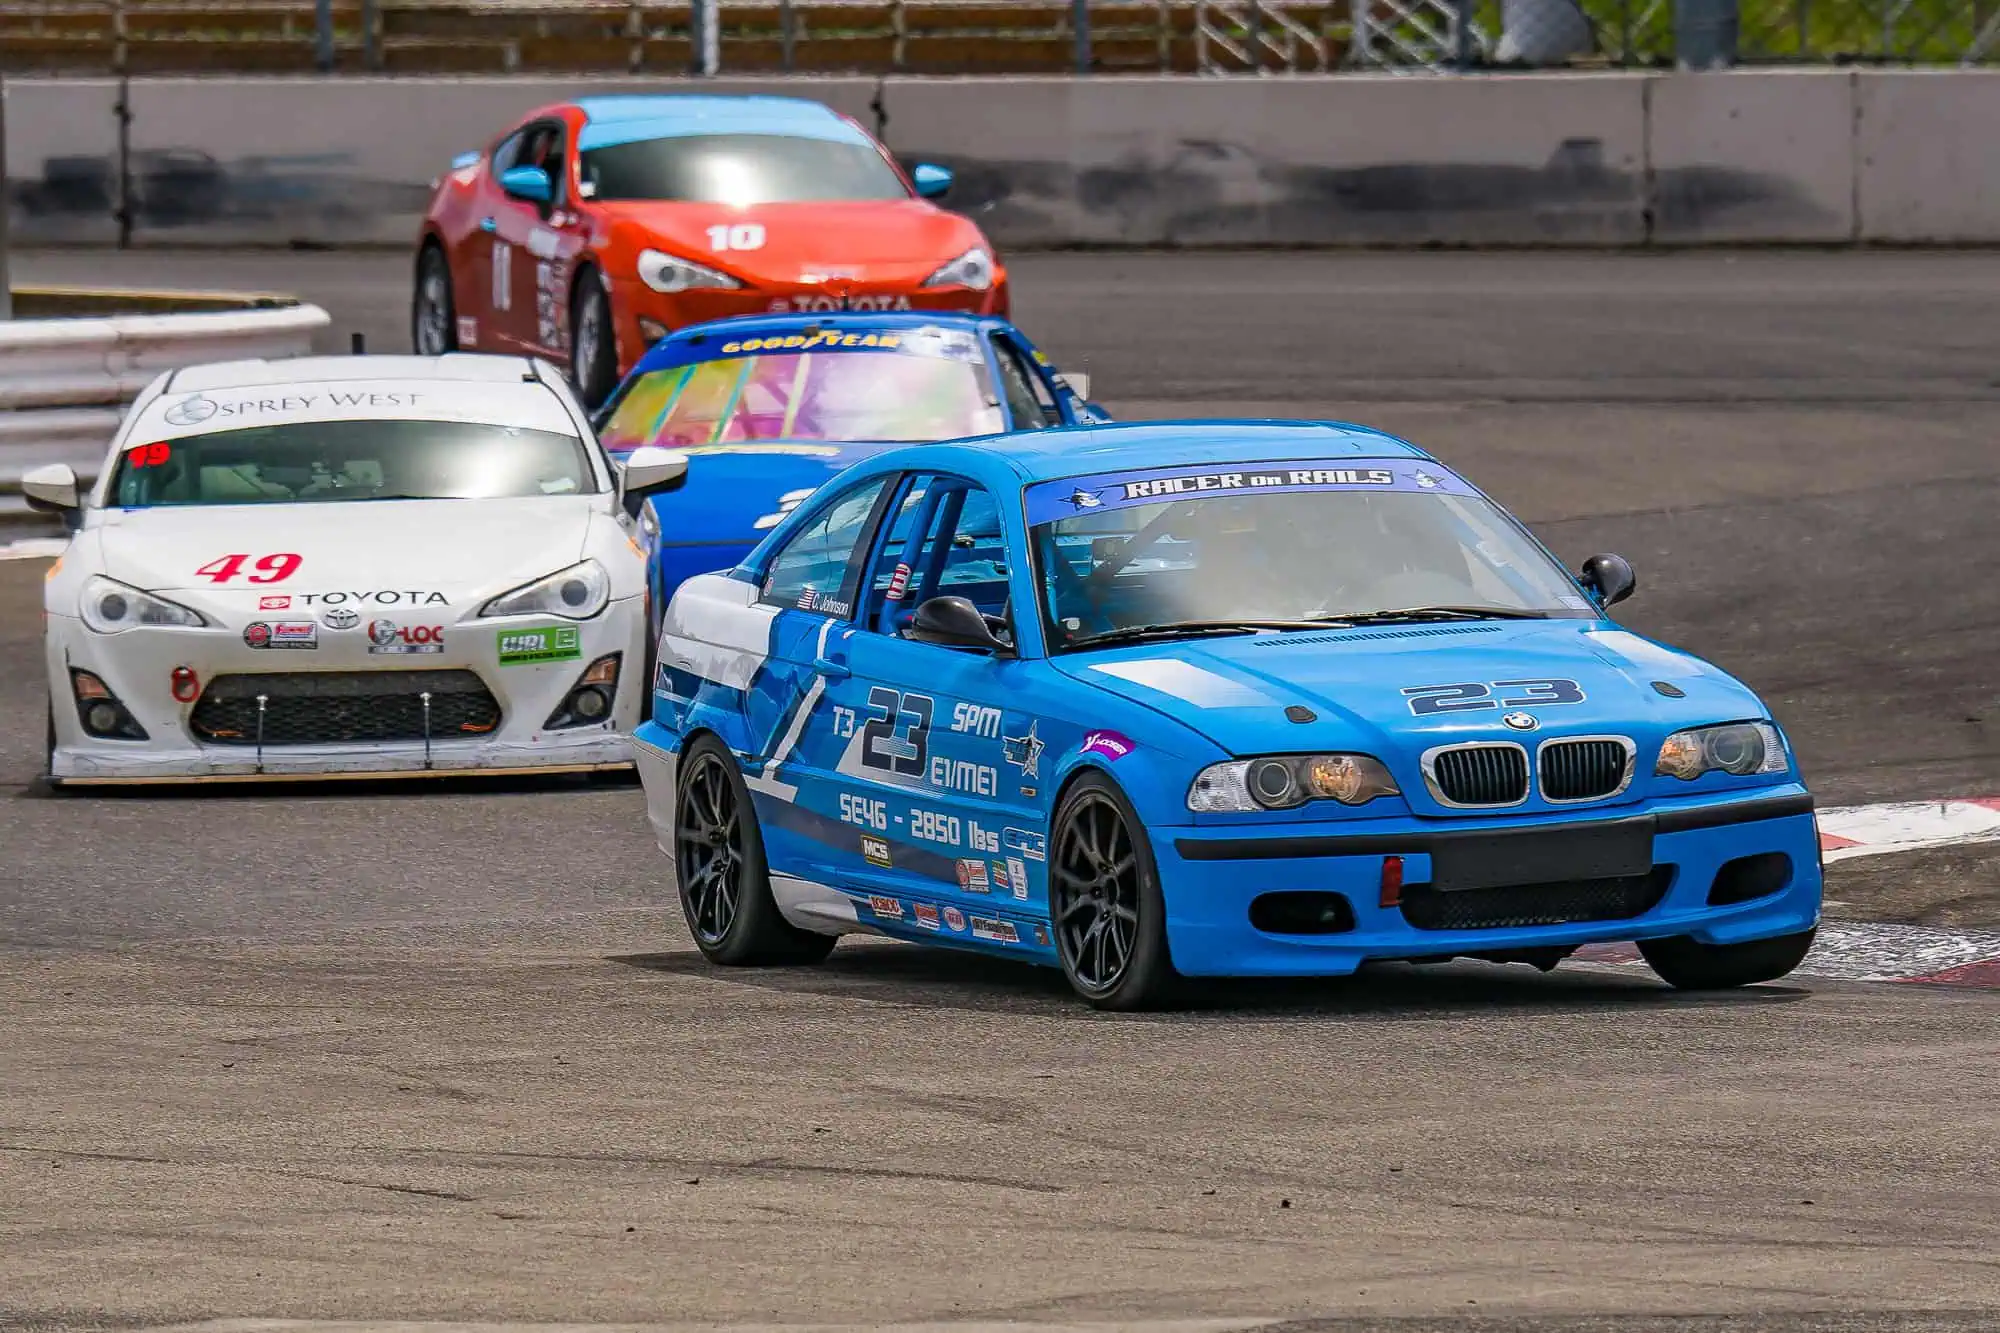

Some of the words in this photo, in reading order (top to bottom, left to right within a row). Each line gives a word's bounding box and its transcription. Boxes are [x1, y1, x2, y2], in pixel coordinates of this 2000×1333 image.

[706, 224, 767, 251] 10
[721, 329, 900, 353] GOODYEAR
[328, 391, 426, 407] WEST
[1126, 473, 1244, 499] RACER
[1249, 474, 1282, 487] on
[1289, 470, 1392, 486] RAILS
[194, 553, 304, 584] 49
[298, 590, 450, 606] TOYOTA
[811, 593, 820, 610] C.
[819, 594, 849, 616] Johnson
[1400, 678, 1587, 717] 23
[832, 705, 857, 739] T3
[861, 686, 935, 779] 23
[950, 702, 1003, 739] SPM
[930, 756, 998, 797] E1/ME1
[910, 808, 961, 846] 2850
[863, 839, 889, 860] MCS
